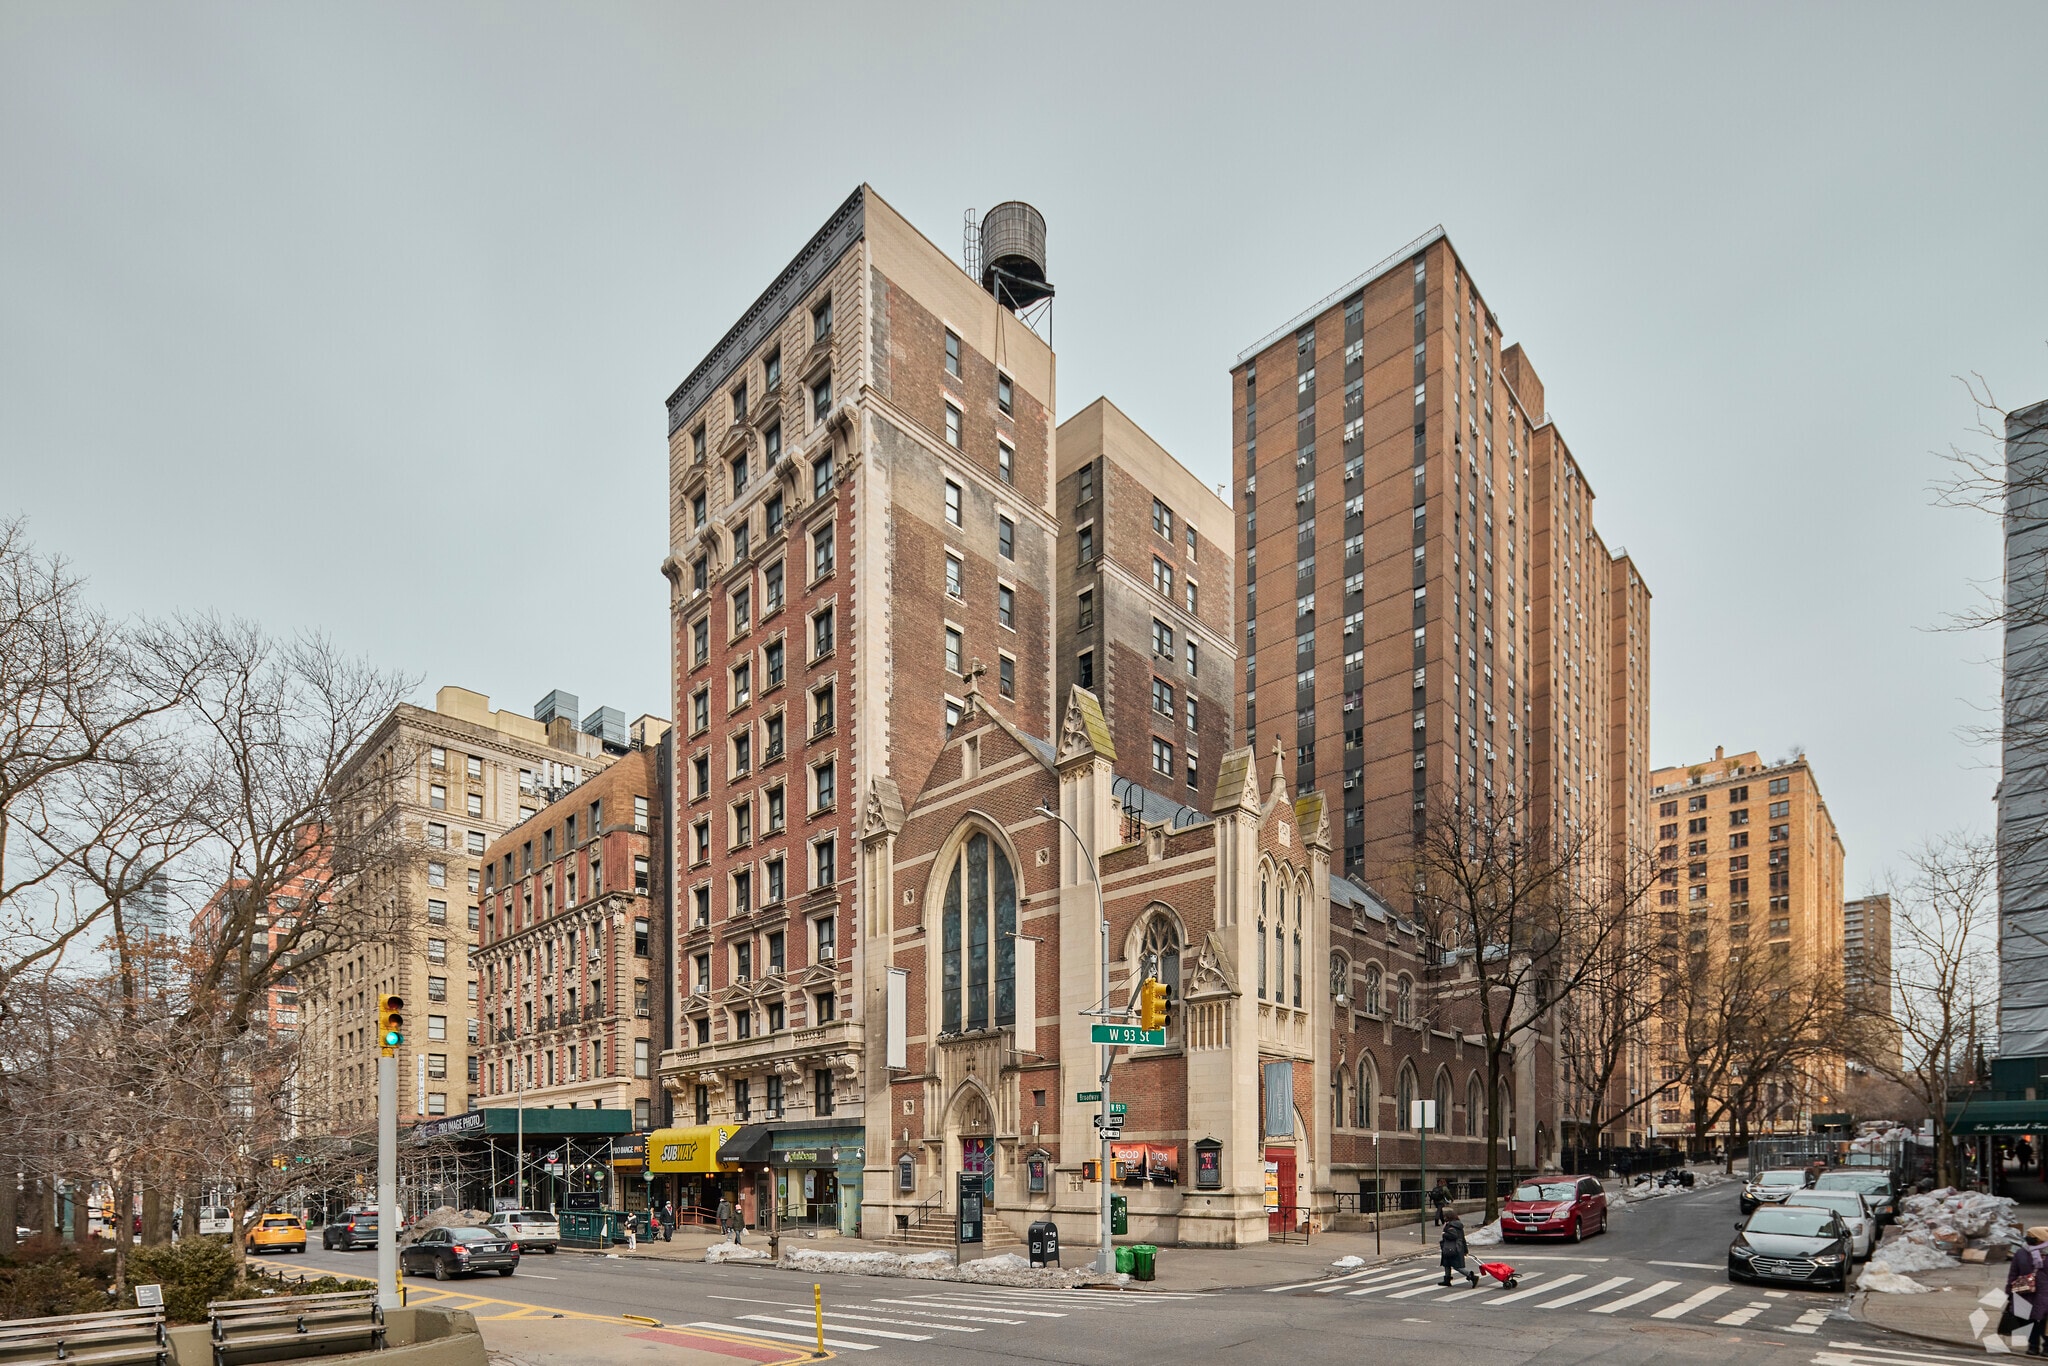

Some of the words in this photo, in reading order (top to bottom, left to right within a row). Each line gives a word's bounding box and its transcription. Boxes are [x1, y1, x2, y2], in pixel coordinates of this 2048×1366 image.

[1109, 1028, 1119, 1041] W
[1123, 1029, 1136, 1042] 93
[1139, 1030, 1150, 1043] St
[1079, 1093, 1099, 1101] Broadway
[1115, 1104, 1121, 1112] 93
[438, 1122, 448, 1134] PRO
[447, 1118, 463, 1132] IMAGE
[462, 1114, 481, 1129] PHOTO
[620, 1145, 634, 1154] IMAGE
[633, 1145, 644, 1153] PHO
[661, 1142, 698, 1162] SUBWAY
[1118, 1150, 1139, 1159] GOD
[1151, 1152, 1168, 1162] DIOS
